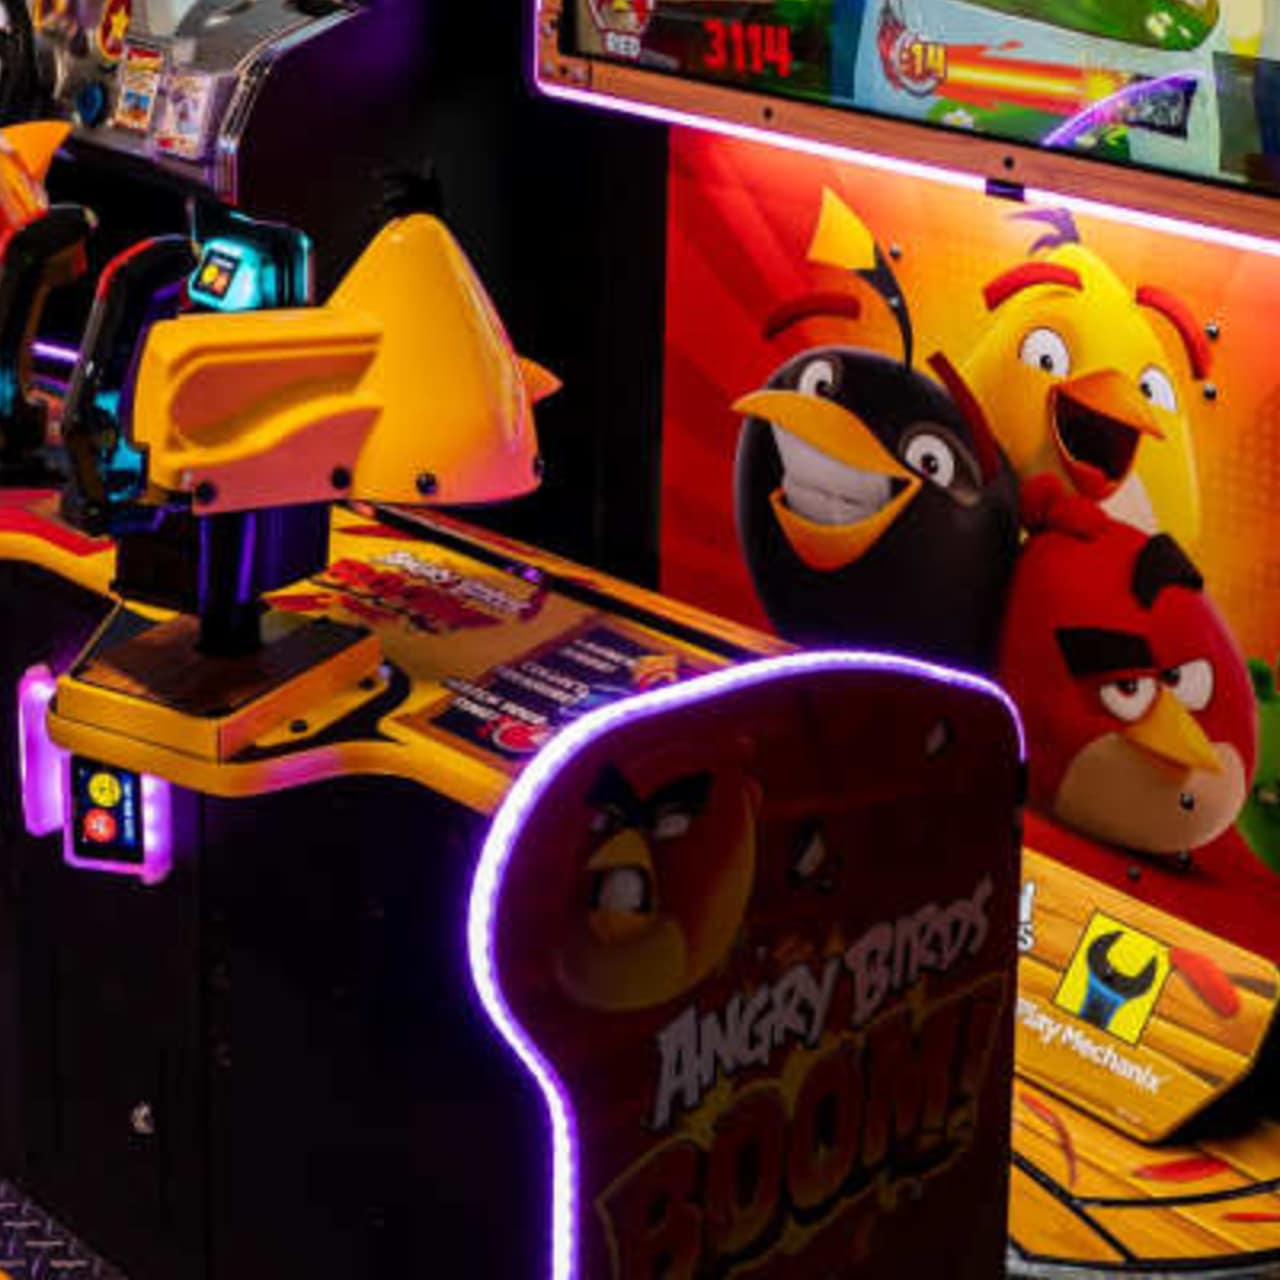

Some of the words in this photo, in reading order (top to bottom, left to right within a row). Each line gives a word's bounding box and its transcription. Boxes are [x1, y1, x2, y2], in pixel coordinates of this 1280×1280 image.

[653, 958, 840, 1132] ANGRY
[845, 872, 995, 1028] BIRDS
[1061, 1024, 1161, 1095] Mechanix
